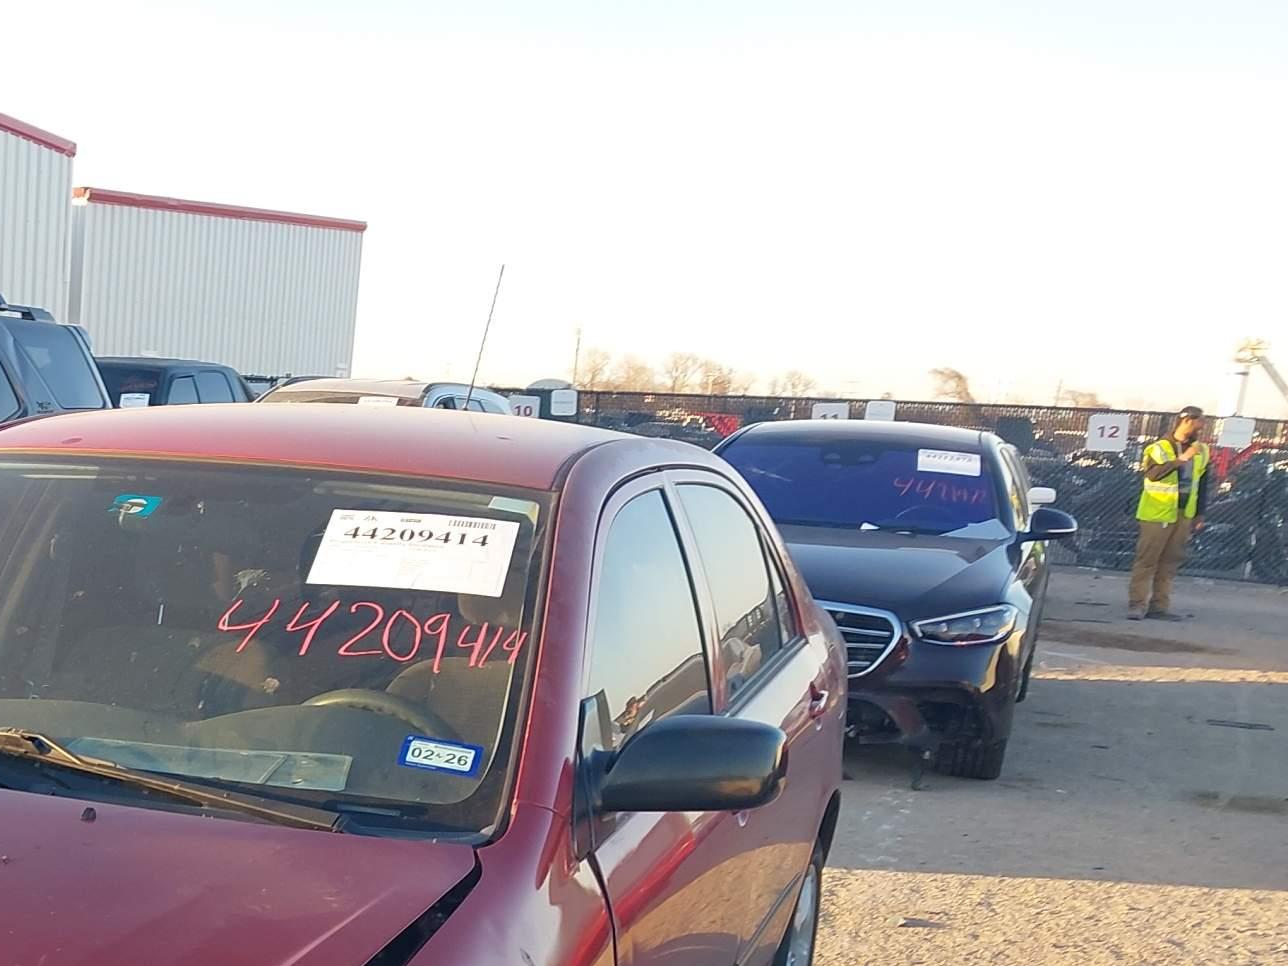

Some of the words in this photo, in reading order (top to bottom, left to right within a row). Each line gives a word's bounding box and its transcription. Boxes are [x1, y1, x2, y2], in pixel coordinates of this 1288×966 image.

[513, 405, 534, 417] 10
[1096, 425, 1120, 438] 12
[343, 525, 490, 547] 44209414
[410, 747, 435, 761] 02
[443, 753, 469, 767] 26
